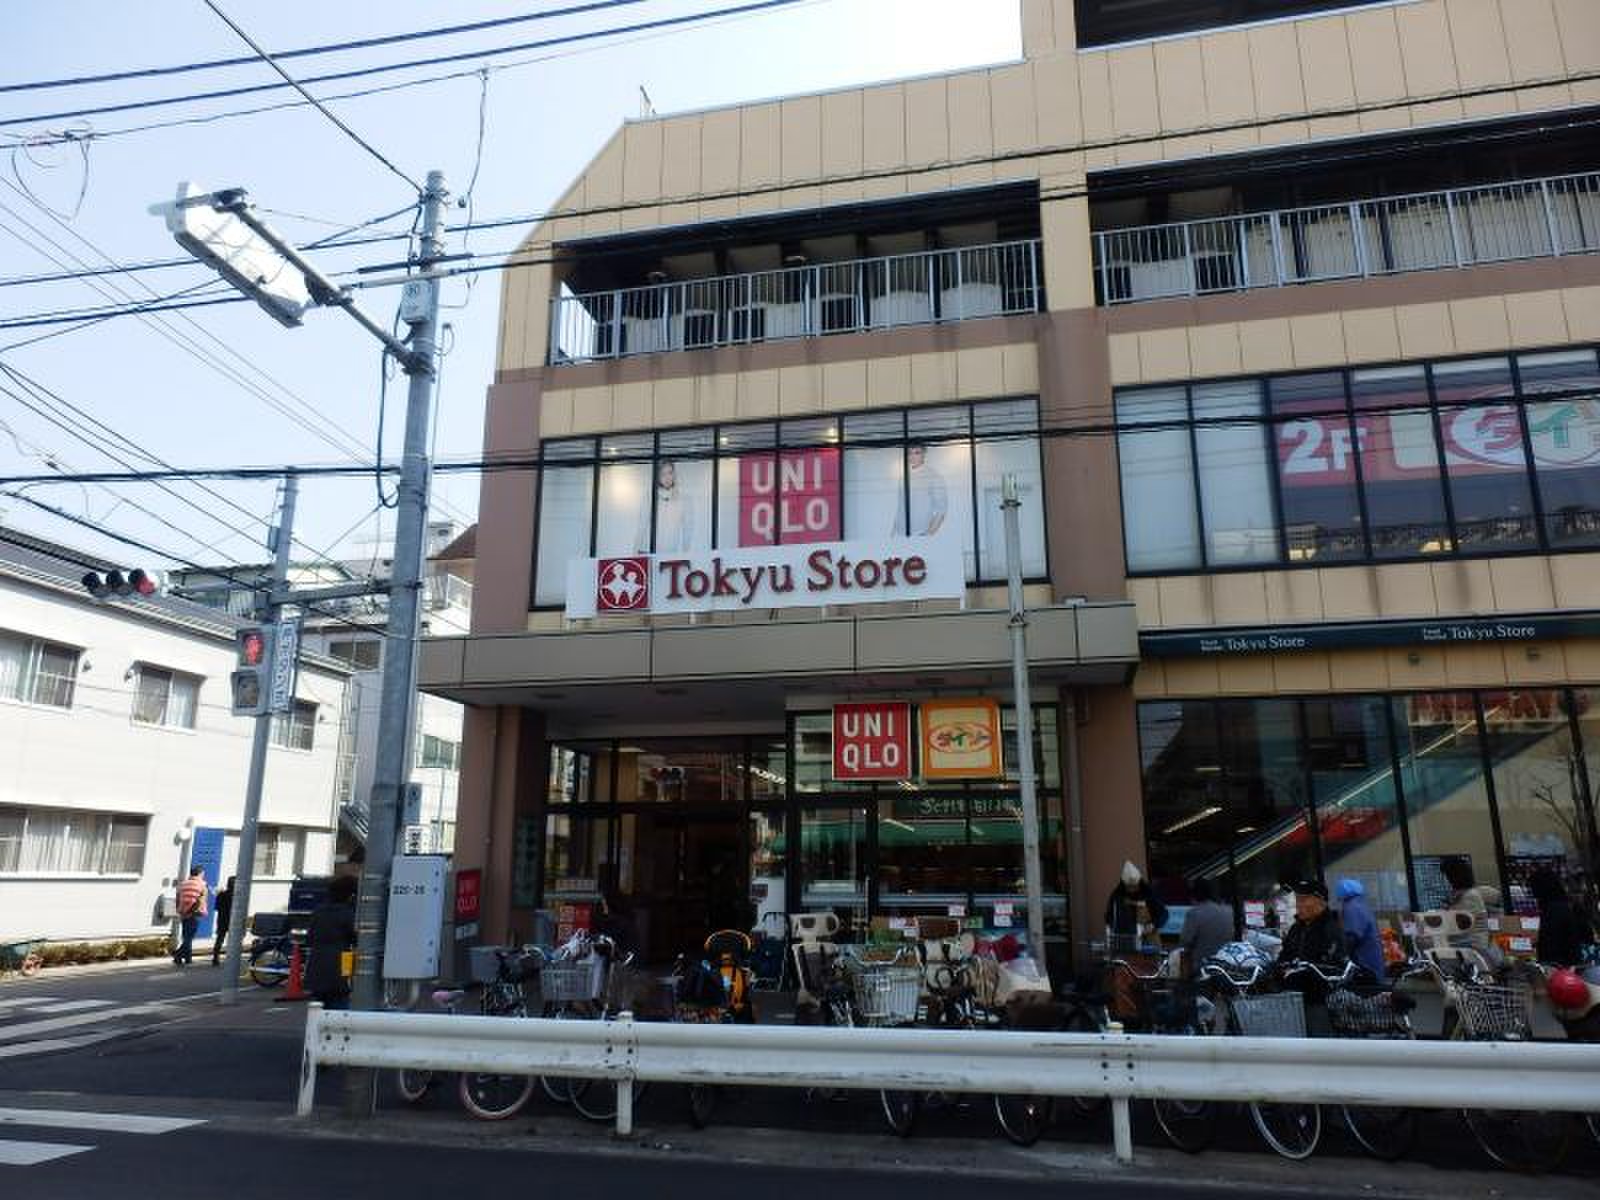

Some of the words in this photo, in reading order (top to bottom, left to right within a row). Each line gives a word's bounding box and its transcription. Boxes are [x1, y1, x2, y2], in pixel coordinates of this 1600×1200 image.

[1280, 419, 1366, 475] 2F
[752, 457, 823, 494] UNI
[751, 498, 830, 541] QLO
[659, 557, 794, 604] Tokyu
[807, 550, 927, 591] Store
[1225, 638, 1267, 652] Tokyu
[1268, 635, 1306, 649] Store
[1447, 626, 1493, 641] Tokyu
[1496, 624, 1536, 638] Store
[842, 711, 894, 737] UNI
[842, 742, 899, 772] QLO
